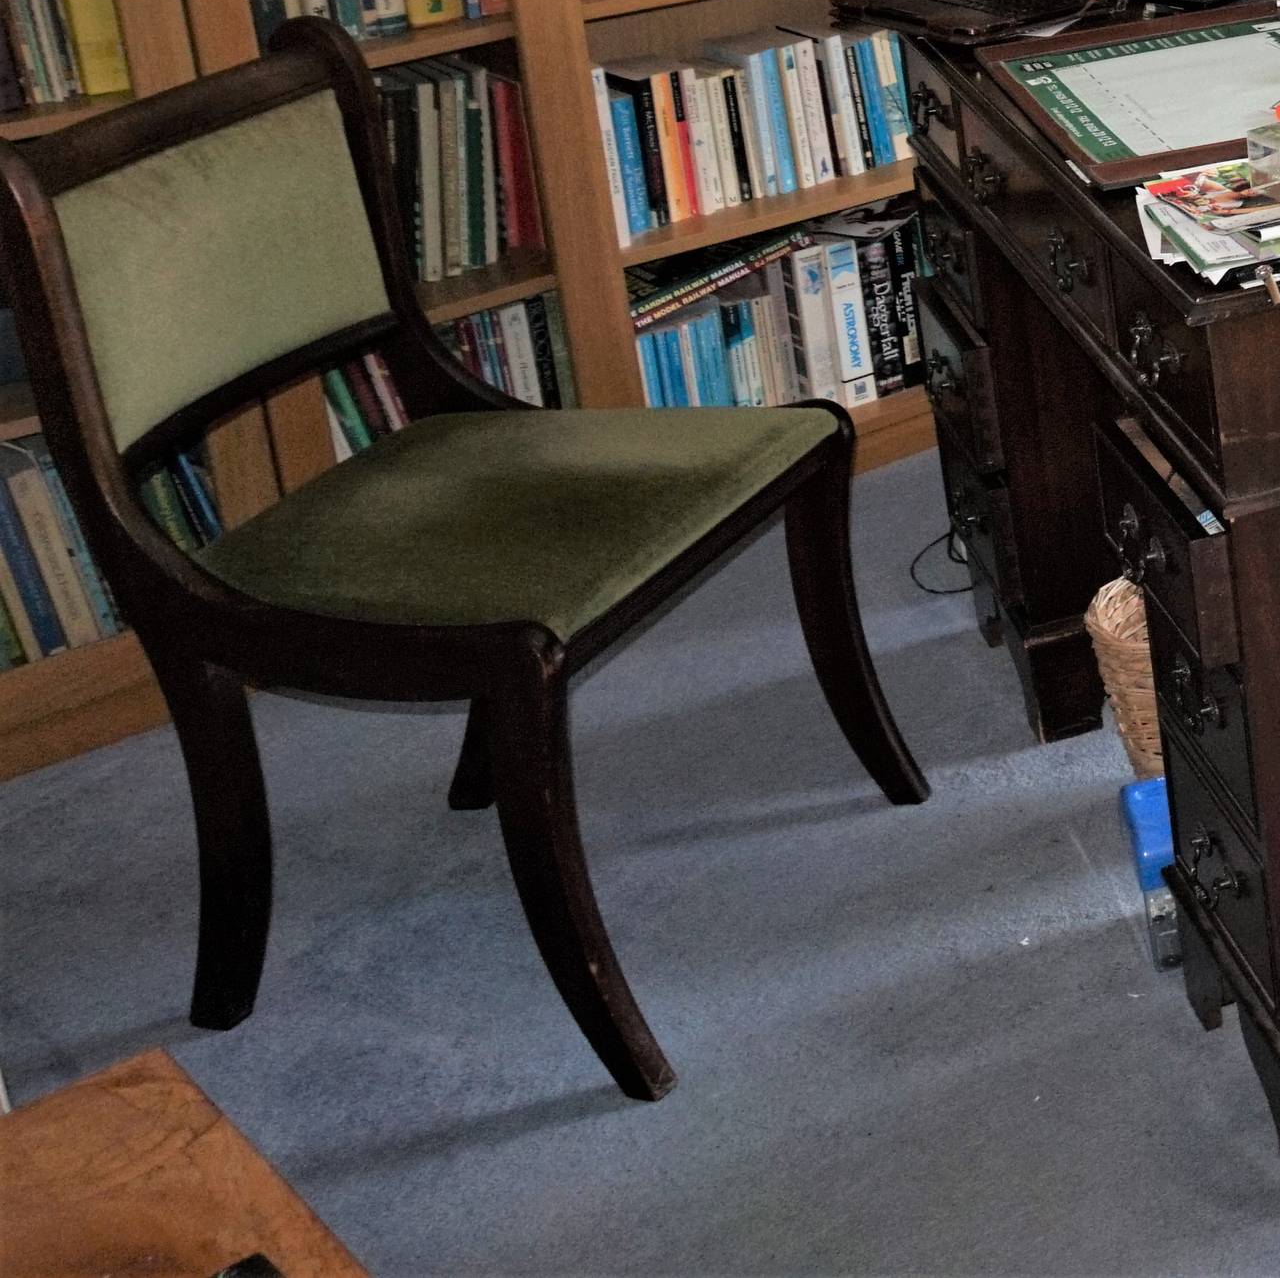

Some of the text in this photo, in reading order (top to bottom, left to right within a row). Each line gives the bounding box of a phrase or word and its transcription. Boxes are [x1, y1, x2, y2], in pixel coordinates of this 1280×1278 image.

[604, 129, 616, 167] SEBASTIAN
[636, 315, 654, 328] THE
[654, 302, 681, 319] MODEL
[683, 286, 716, 305] RAILWAY
[718, 269, 750, 288] MANUAL
[638, 293, 672, 313] GARDEN
[674, 277, 709, 297] RAILWAY
[711, 258, 745, 280] MANUAL
[762, 237, 789, 255] FREEZER
[843, 302, 863, 368] ASTRONOMY
[872, 283, 898, 362] Daggerfall
